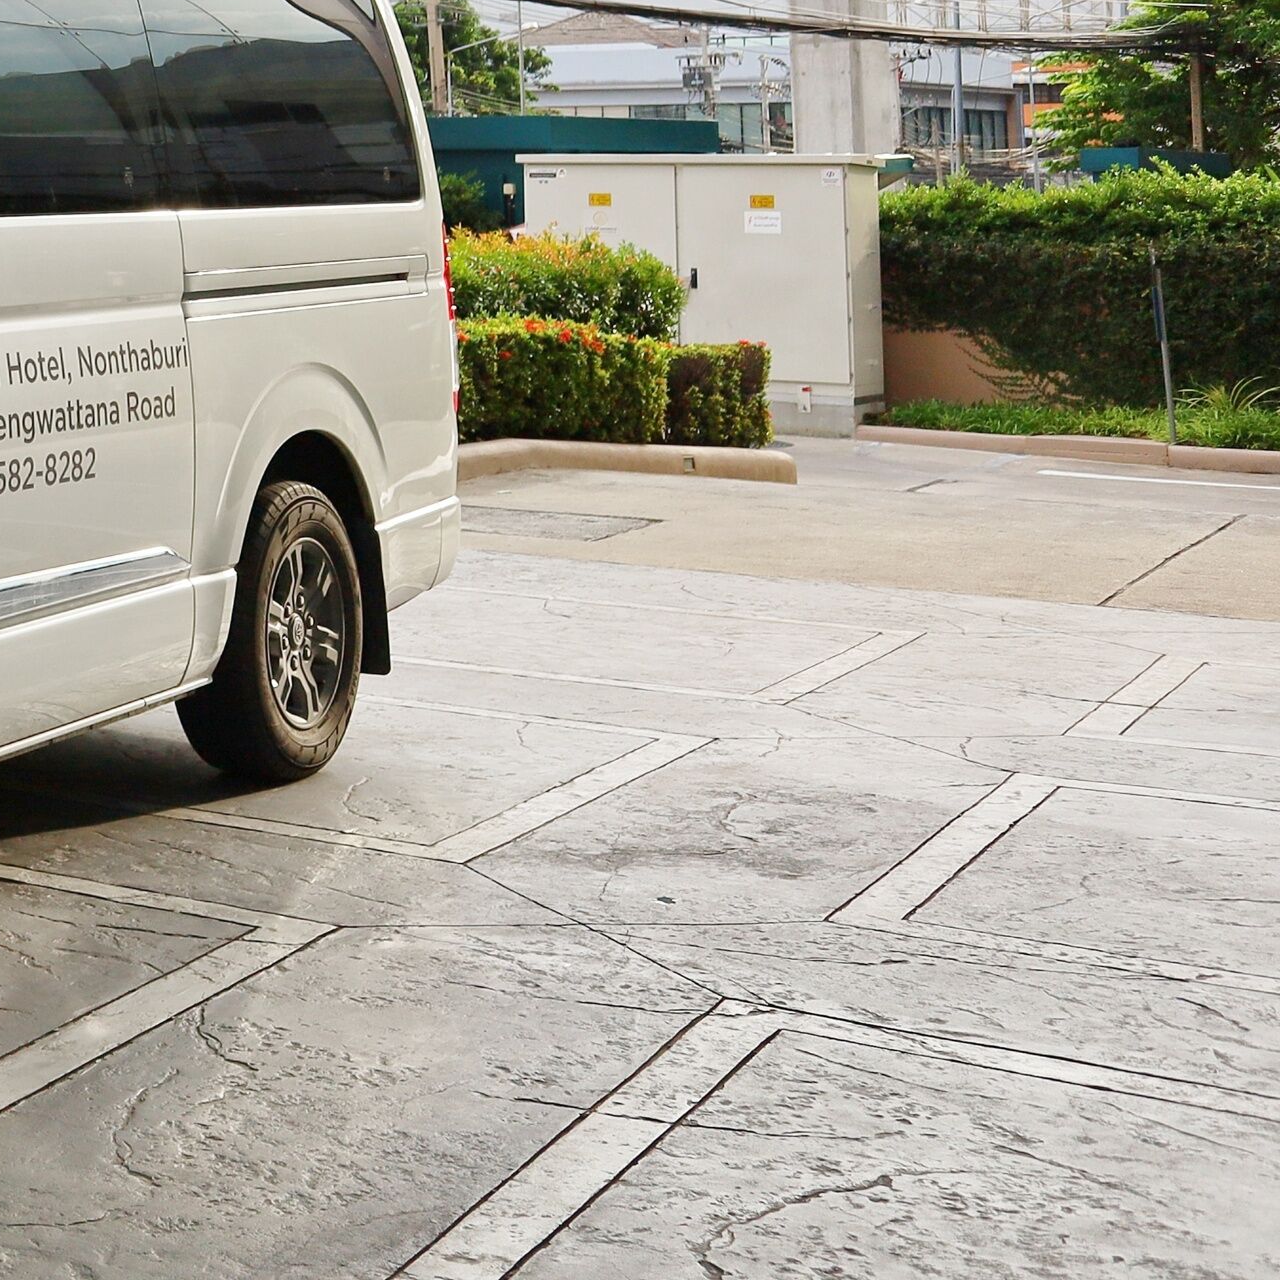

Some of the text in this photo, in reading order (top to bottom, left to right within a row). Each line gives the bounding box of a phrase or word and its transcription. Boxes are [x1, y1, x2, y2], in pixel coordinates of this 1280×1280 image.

[6, 346, 73, 385] Hotel,
[77, 337, 189, 378] Nonthaburi
[126, 385, 177, 422] Road
